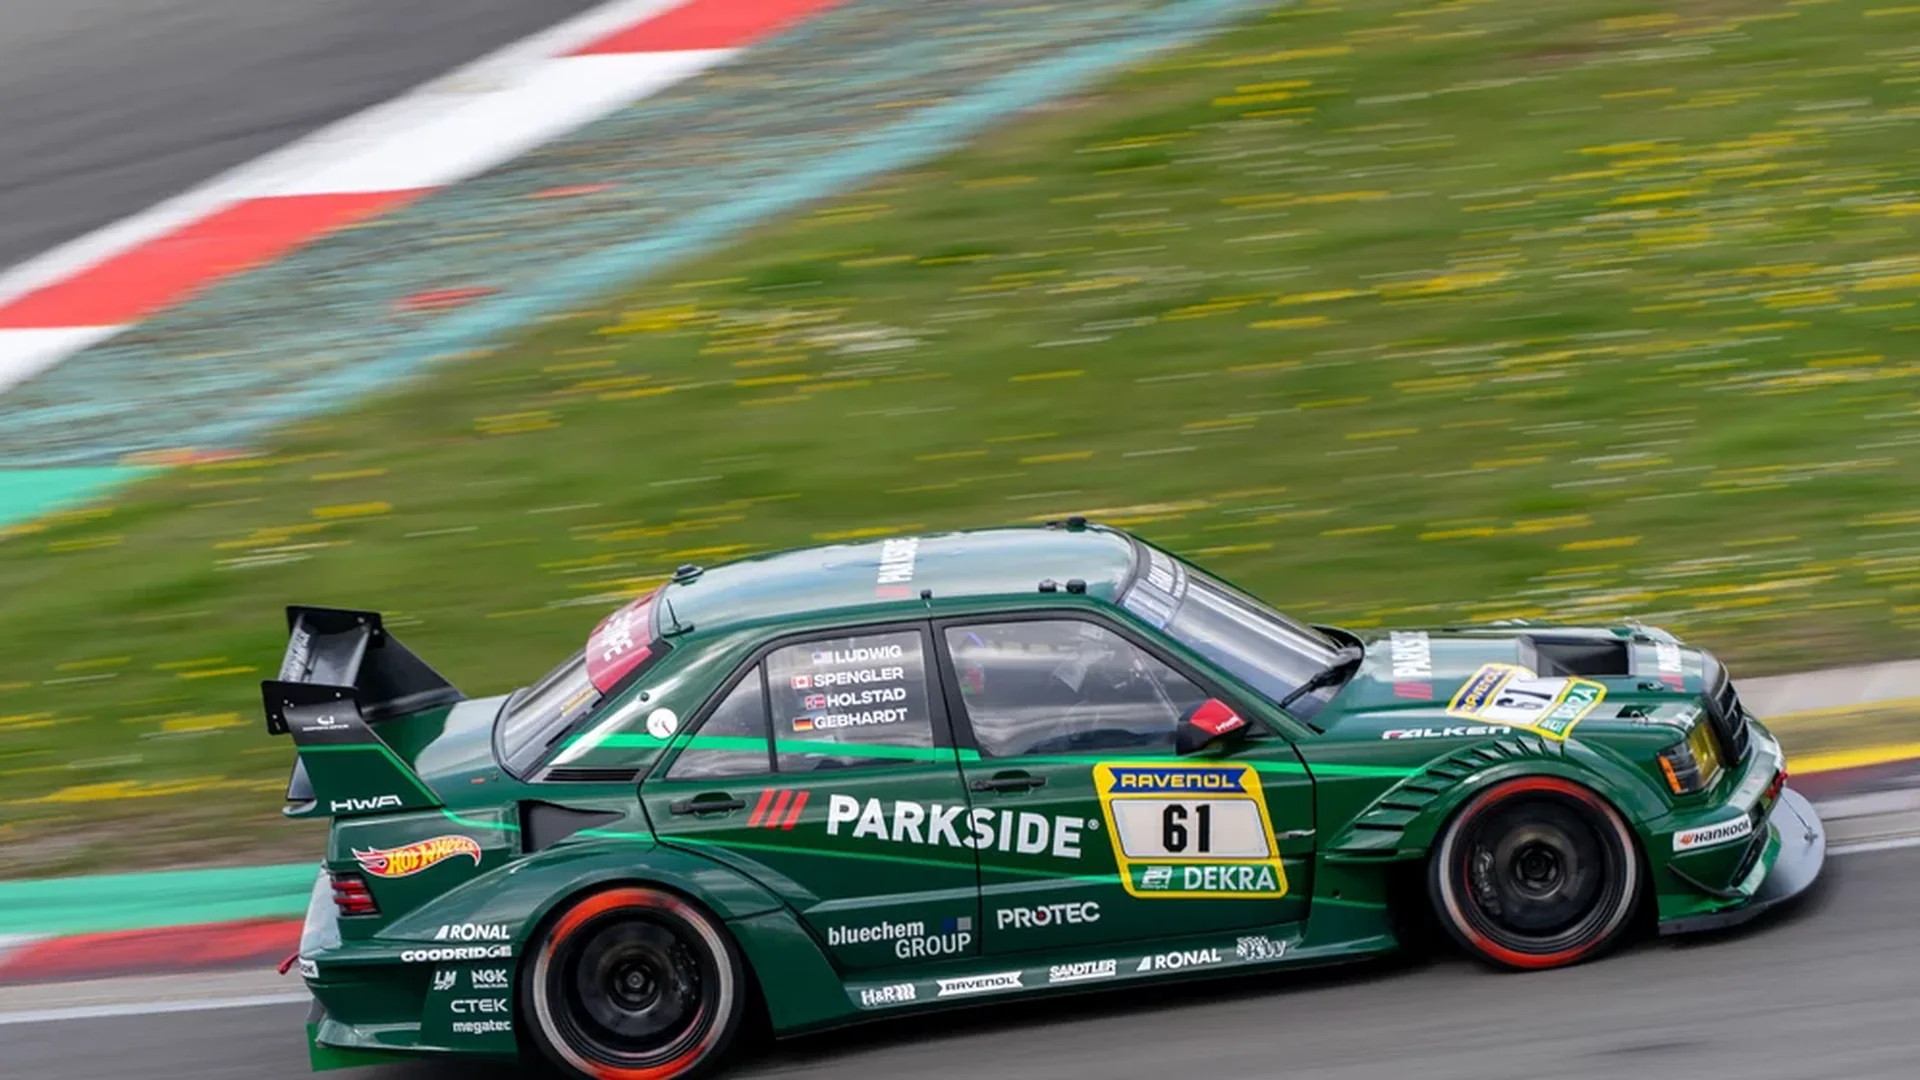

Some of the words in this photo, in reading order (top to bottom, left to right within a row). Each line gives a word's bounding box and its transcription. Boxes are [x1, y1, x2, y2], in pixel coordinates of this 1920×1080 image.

[834, 645, 902, 664] LUDWIG
[813, 667, 904, 688] SPENGLER
[827, 688, 906, 708] HOLSTAD
[814, 708, 908, 730] GEBHARDT
[1382, 725, 1512, 741] FALKEN
[1120, 774, 1236, 789] RAVENOL
[330, 795, 403, 812] HWA
[1162, 803, 1212, 854] 61
[1183, 865, 1277, 891] DEKRA
[997, 901, 1101, 929] PROTEC
[449, 923, 511, 941] RONAL
[828, 920, 925, 947] bluechem
[400, 944, 513, 962] GOODRIDGE
[895, 933, 972, 959] GROUP
[1154, 947, 1222, 970] RONAL
[471, 968, 508, 984] NGK
[945, 976, 1015, 992] RAVENOL
[860, 985, 895, 1006] H&R
[450, 998, 508, 1013] CTEK
[452, 1019, 512, 1035] megatec
